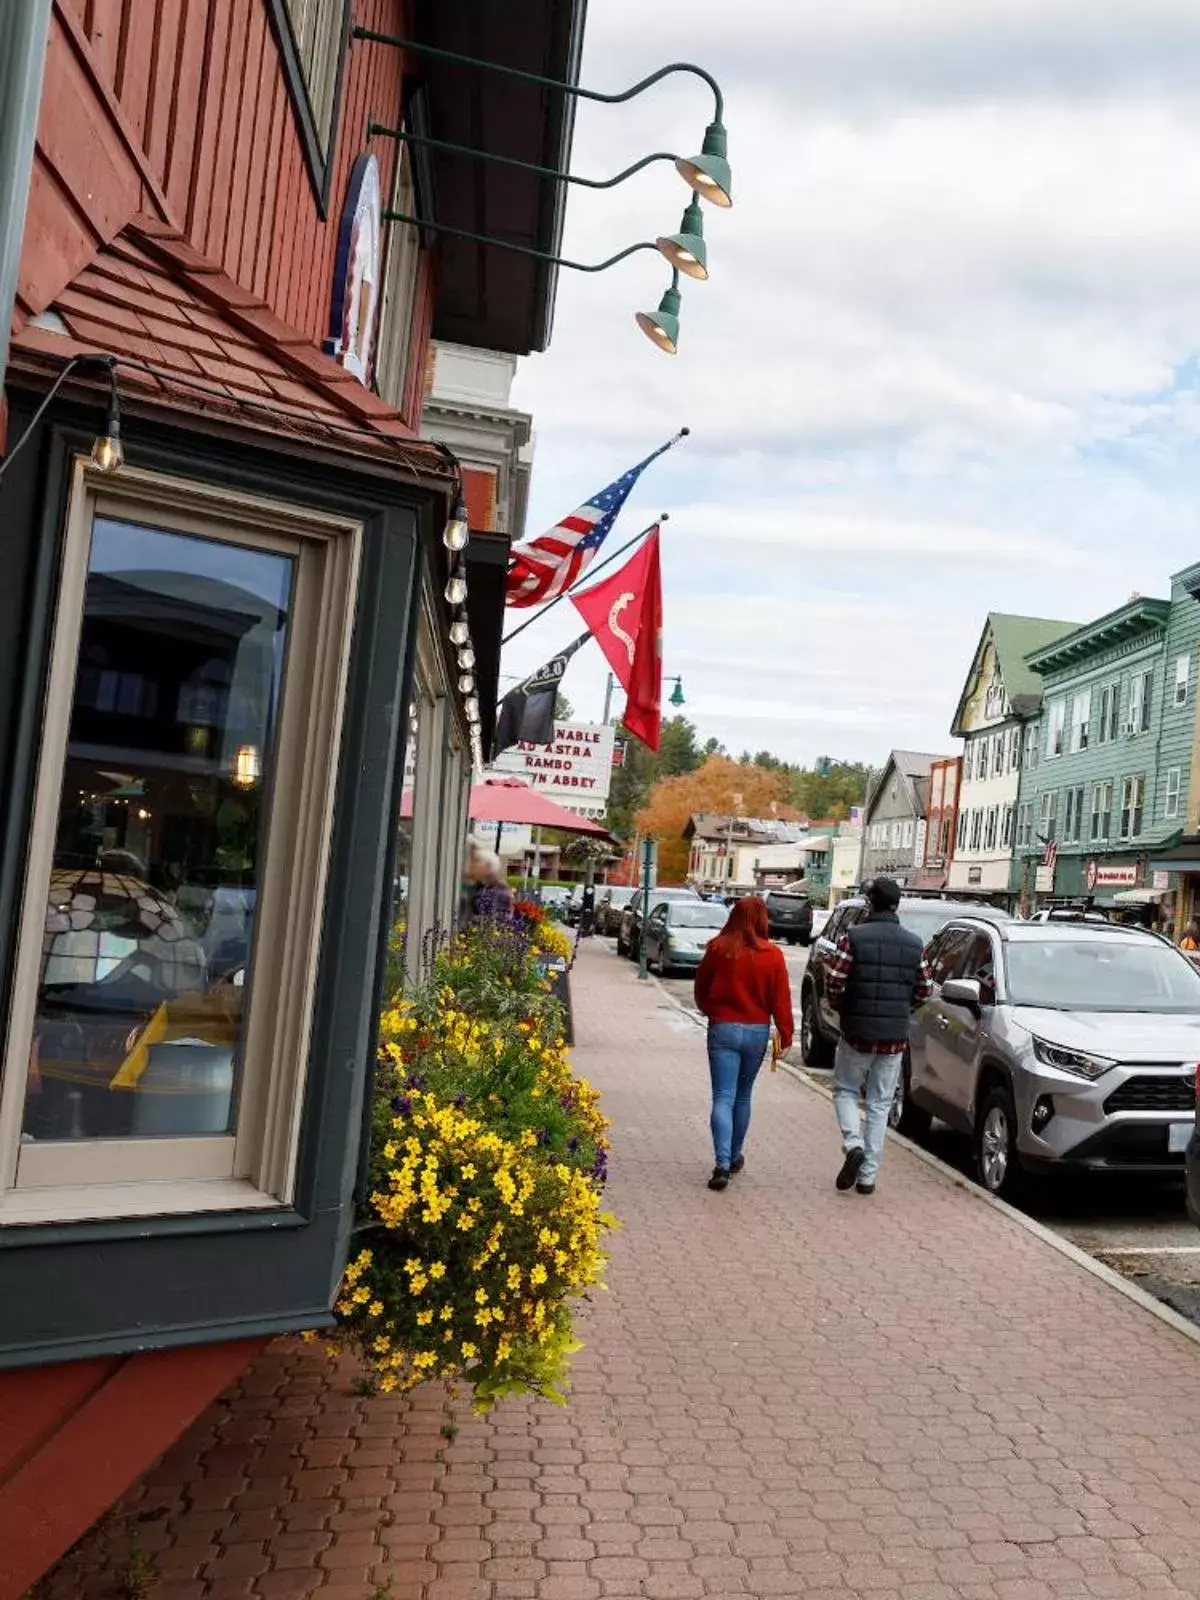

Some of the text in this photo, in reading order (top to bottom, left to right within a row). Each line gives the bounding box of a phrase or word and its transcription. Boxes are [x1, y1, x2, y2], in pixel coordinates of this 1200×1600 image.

[556, 729, 601, 743] NABLE
[517, 740, 592, 757] AD ASTRA
[525, 756, 573, 770] RAMBO
[552, 774, 597, 789] ABBEY
